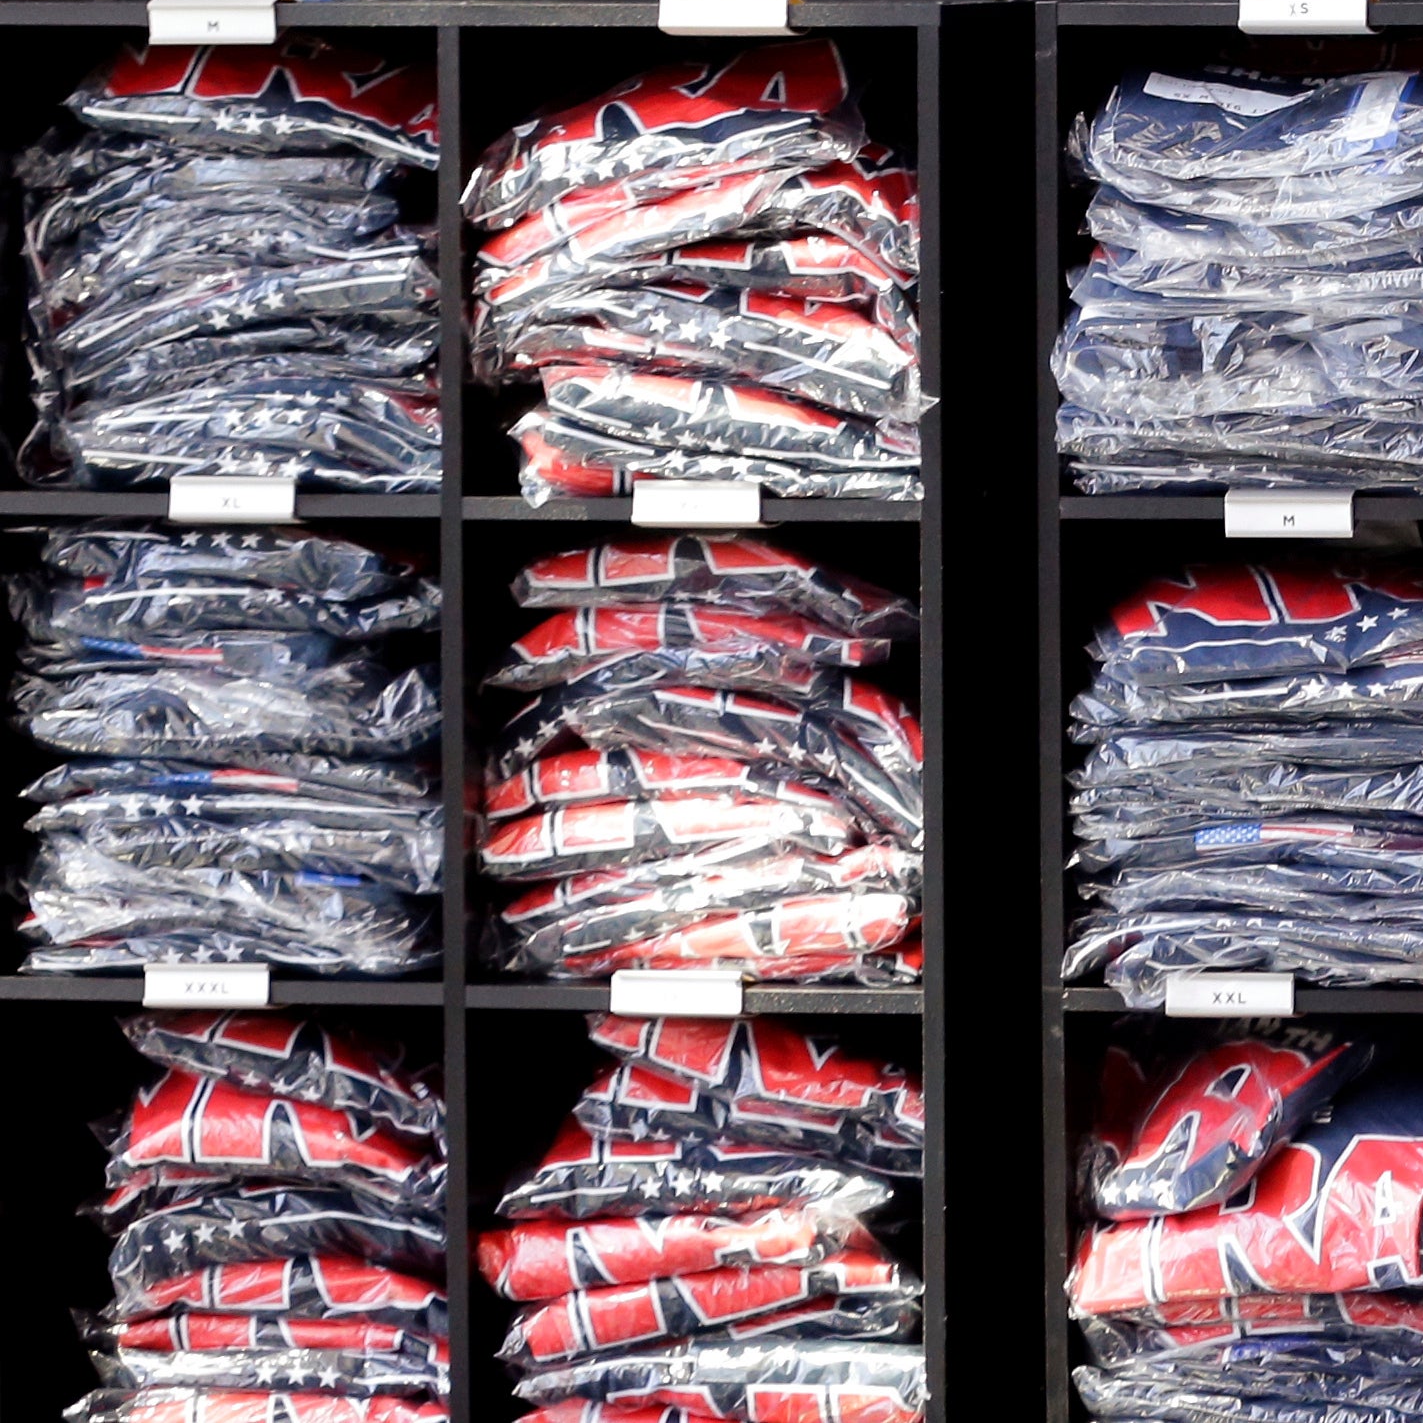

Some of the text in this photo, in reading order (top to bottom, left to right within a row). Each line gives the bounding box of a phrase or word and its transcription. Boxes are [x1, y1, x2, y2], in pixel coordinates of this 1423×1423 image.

[207, 20, 219, 31] M
[1283, 515, 1295, 526] M
[185, 982, 229, 995] XXXL
[1212, 992, 1247, 1005] XXL
